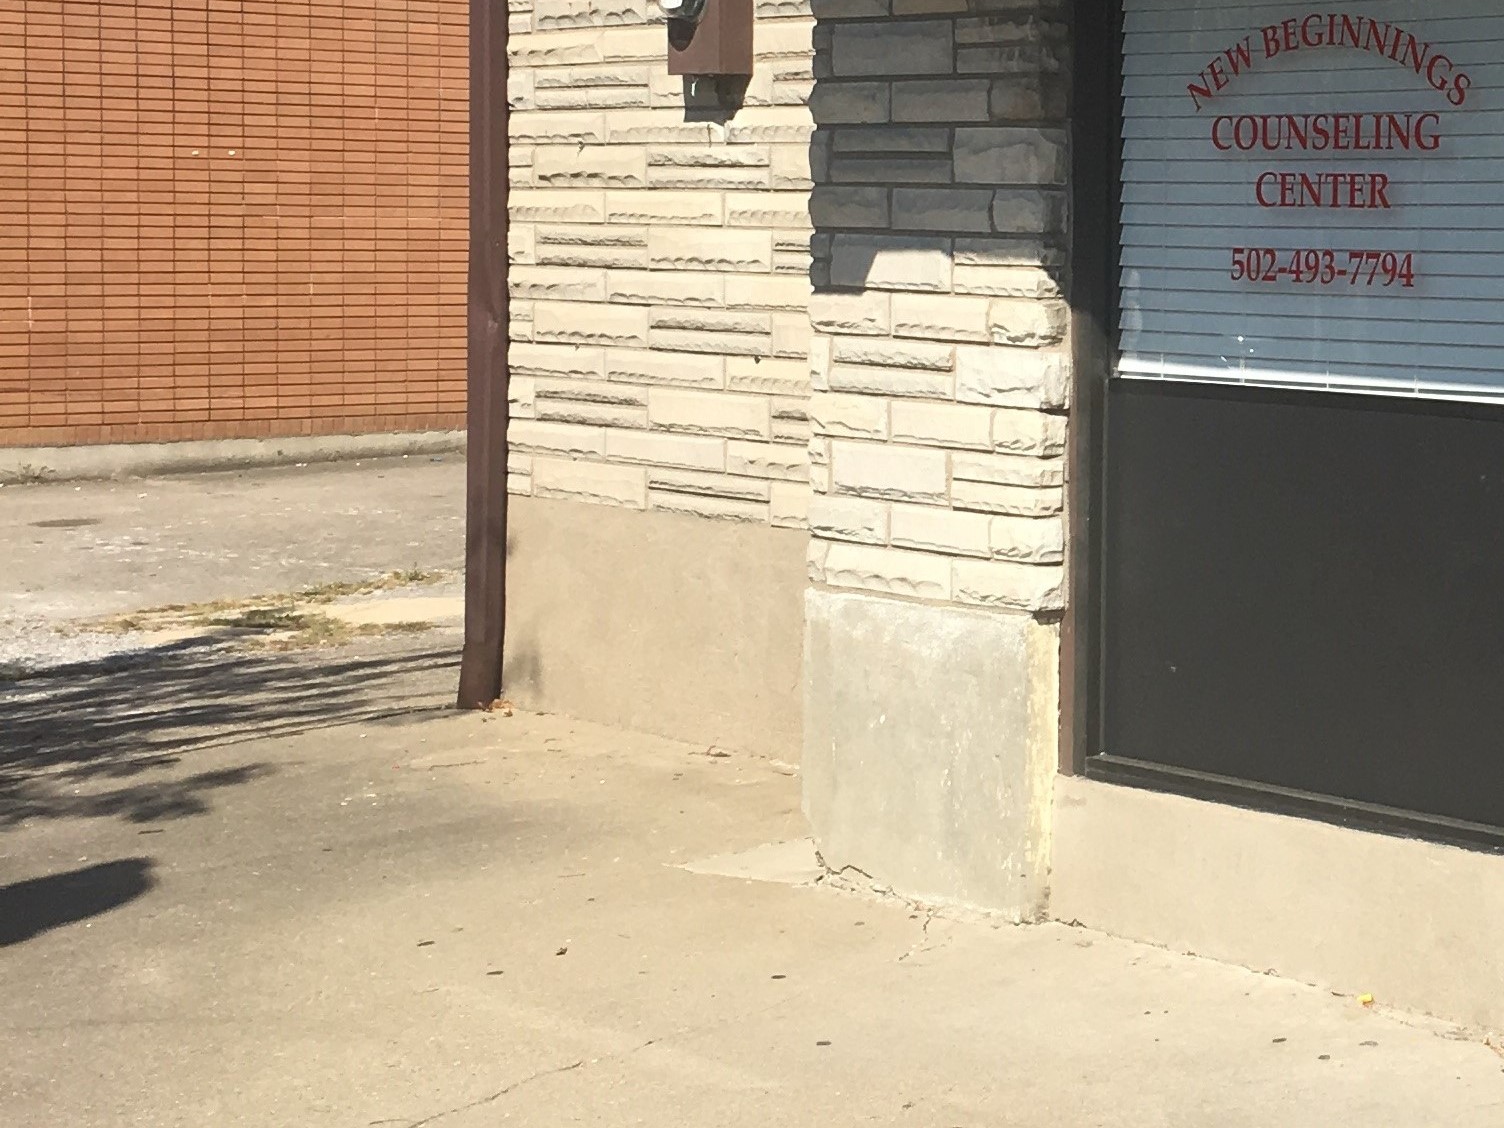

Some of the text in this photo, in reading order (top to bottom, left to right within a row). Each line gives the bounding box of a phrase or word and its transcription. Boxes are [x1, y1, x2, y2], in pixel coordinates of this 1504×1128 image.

[1187, 13, 1471, 111] NEW BEGINNINGS
[1211, 113, 1440, 151] COUNSELING
[1256, 171, 1390, 208] CENTER
[1230, 248, 1414, 287] 502-493-7794
